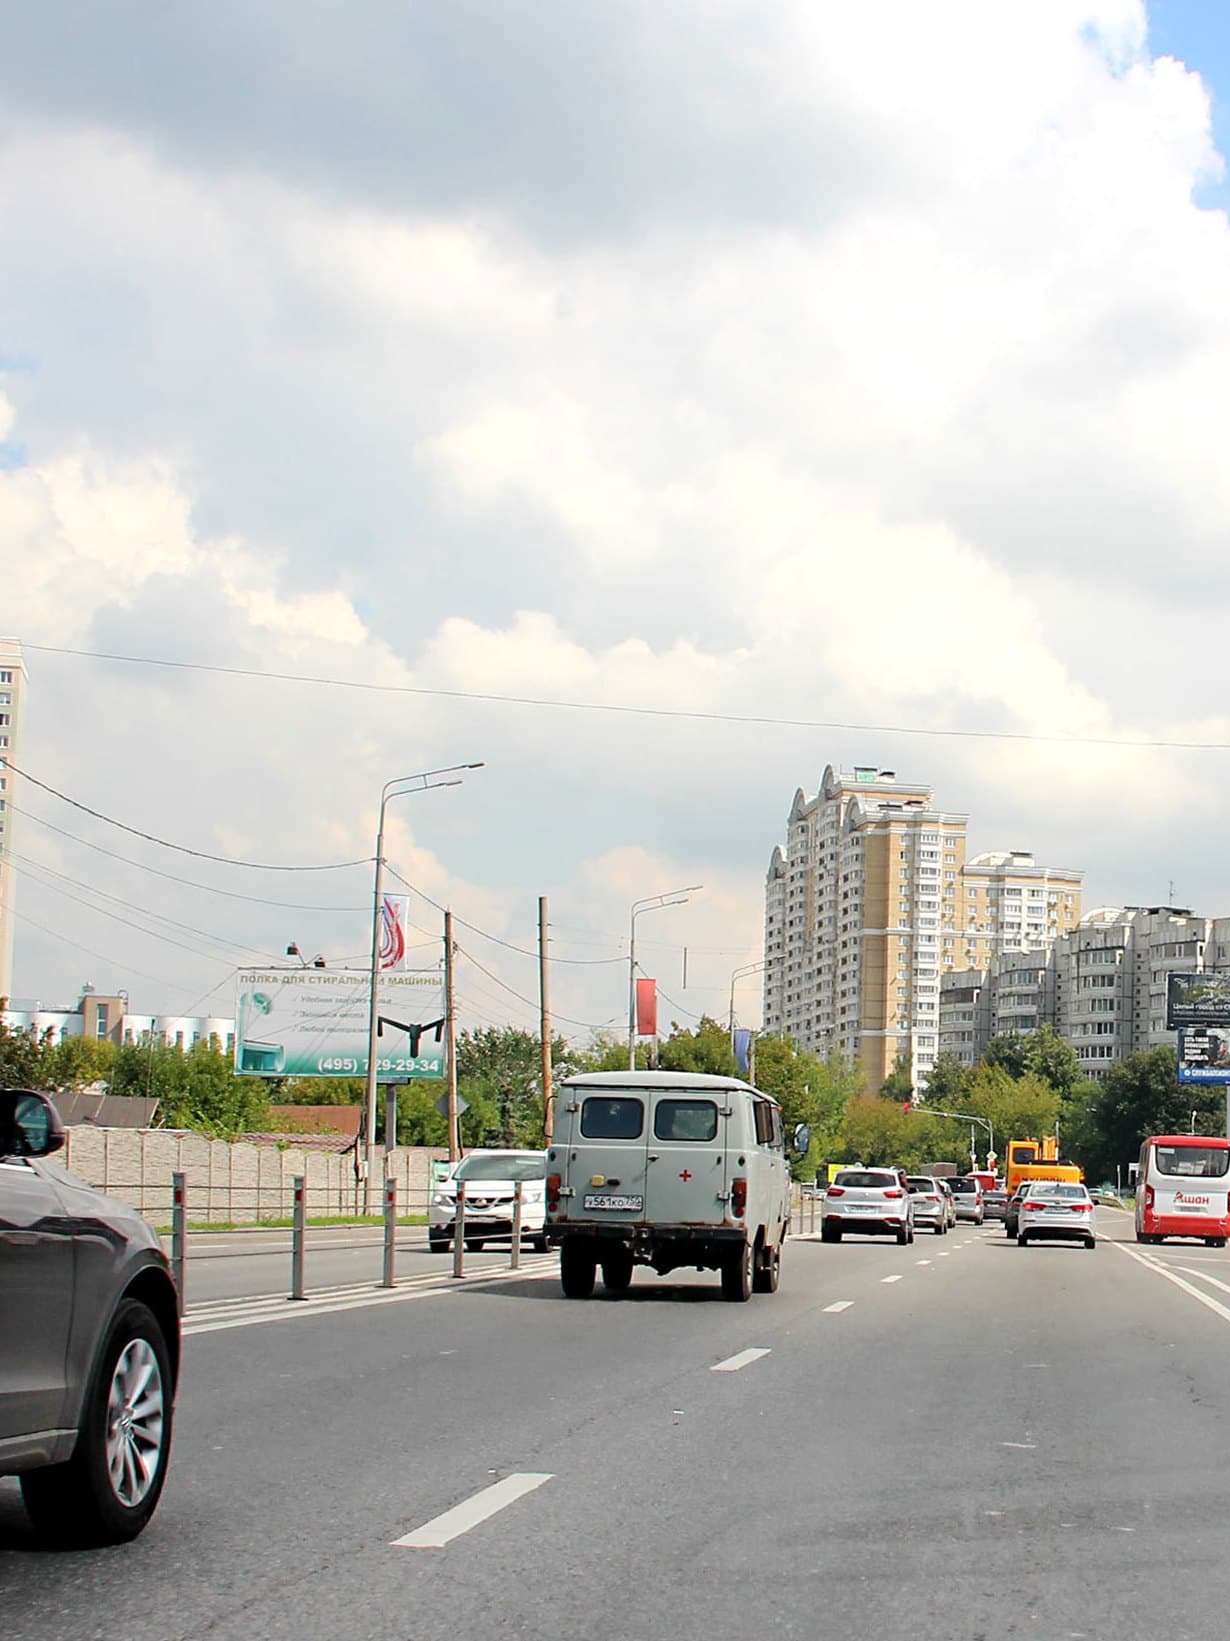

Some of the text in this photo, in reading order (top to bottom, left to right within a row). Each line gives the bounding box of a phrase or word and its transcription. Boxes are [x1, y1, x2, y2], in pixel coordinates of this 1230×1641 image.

[240, 975, 443, 986] ПОЛКА ДЛЯ СТИРАЛЬНЙ МАШИНЫ
[317, 1058, 439, 1073] (495) 729-29-34
